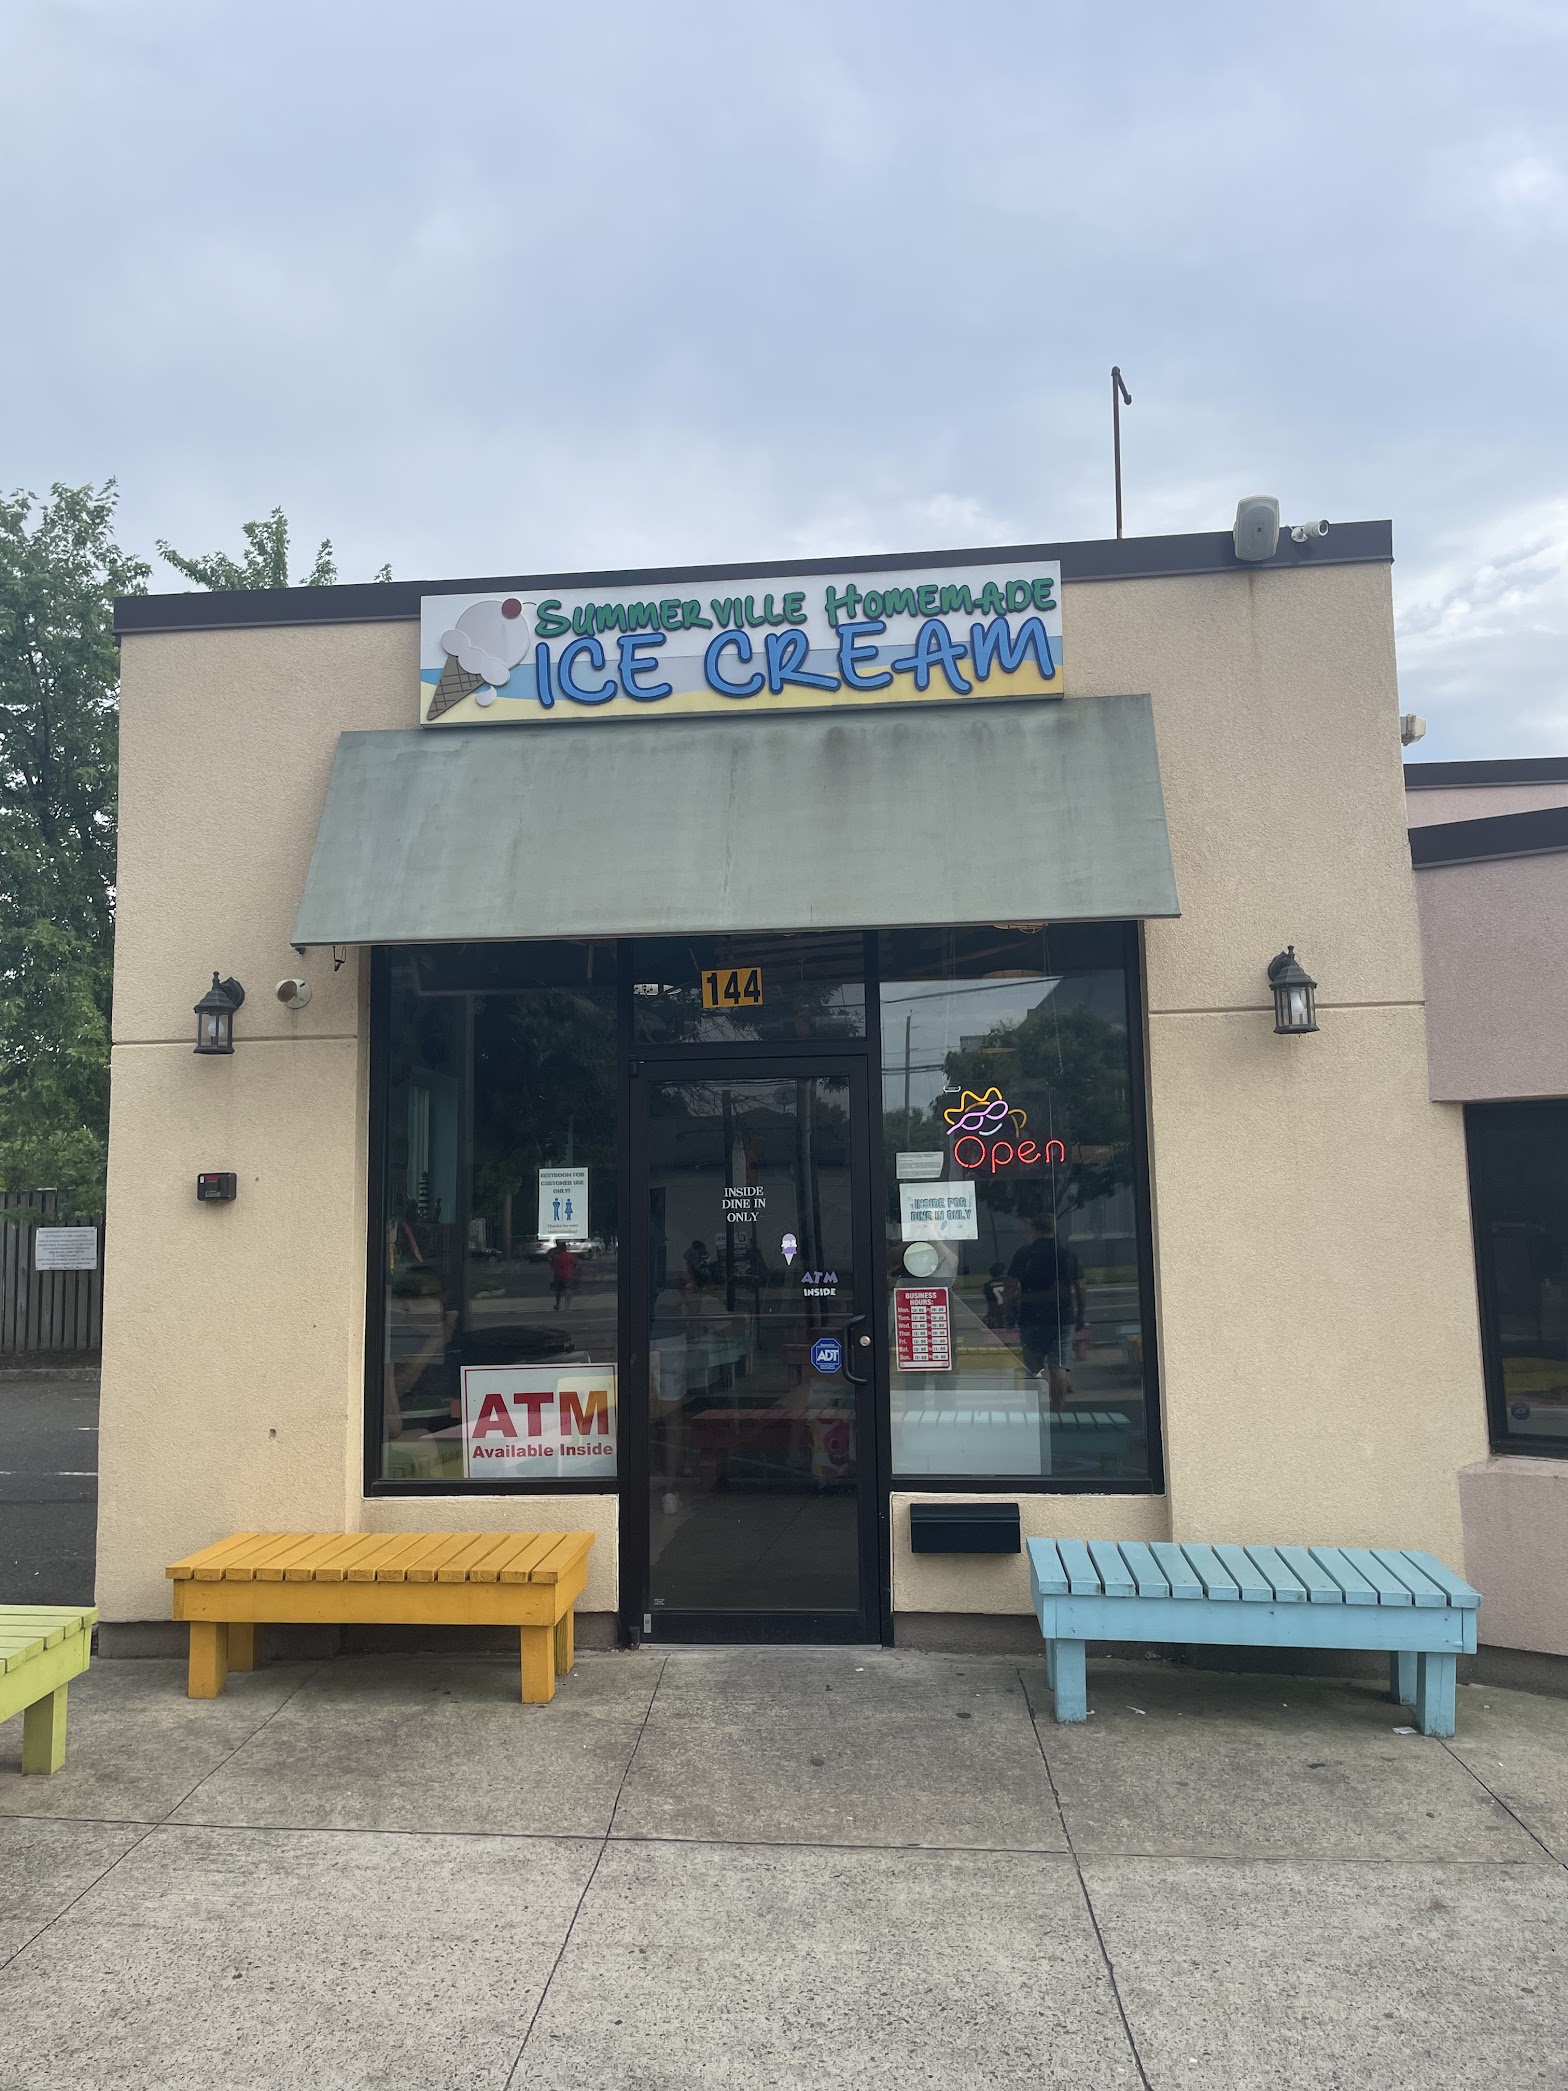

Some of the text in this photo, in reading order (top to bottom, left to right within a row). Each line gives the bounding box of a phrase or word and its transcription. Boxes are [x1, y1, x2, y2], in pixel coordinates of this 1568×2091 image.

[825, 578, 1056, 628] HOMEMADE
[535, 616, 1056, 708] ICE CREAM
[706, 969, 761, 1006] 144
[954, 1135, 1065, 1174] Open
[724, 1186, 764, 1198] INSIDE
[722, 1198, 766, 1209] DINE IN
[914, 1196, 967, 1209] INSIDE FOR
[726, 1212, 759, 1222] ONLY
[910, 1209, 972, 1221] DINE IN ONLY
[800, 1270, 839, 1284] ATM
[803, 1288, 836, 1296] INSIDE
[909, 1298, 934, 1306] HOURS:
[816, 1349, 839, 1362] ADT
[471, 1390, 609, 1439] ATM
[472, 1442, 614, 1459] Available Inside
